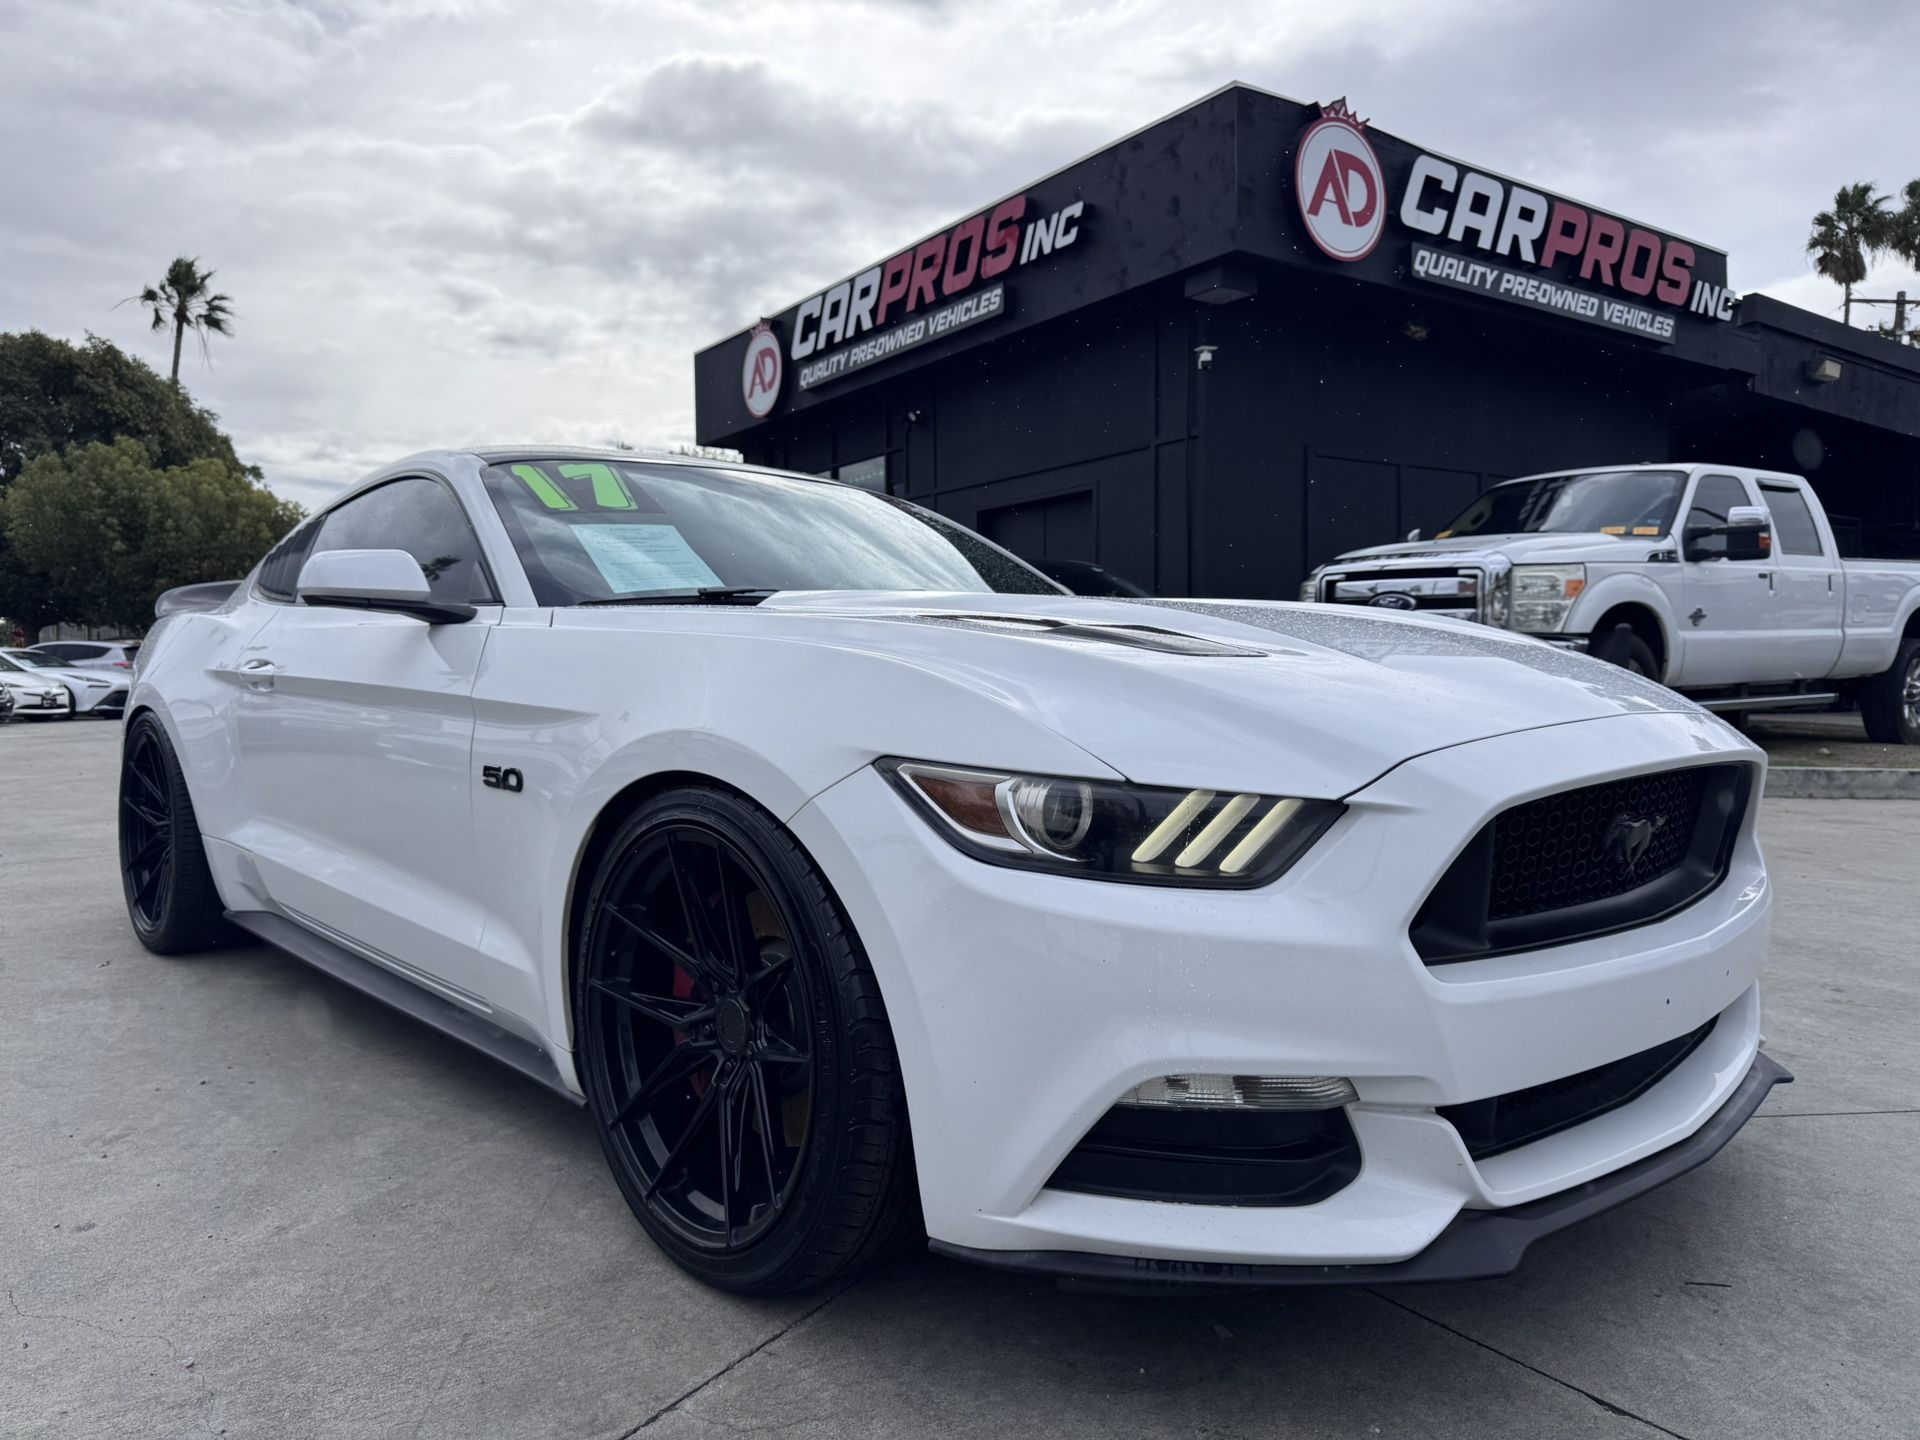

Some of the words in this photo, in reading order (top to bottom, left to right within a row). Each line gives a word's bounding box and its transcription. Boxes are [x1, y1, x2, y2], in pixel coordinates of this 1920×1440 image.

[1308, 148, 1377, 228] AD
[1020, 201, 1085, 265] INC
[1414, 249, 1499, 290] QUALITY
[1603, 300, 1675, 338] VEHICLES
[1690, 280, 1736, 322] INC
[799, 352, 849, 389] QUALITY
[928, 287, 1003, 335] VEHICLES
[511, 464, 639, 512] 17
